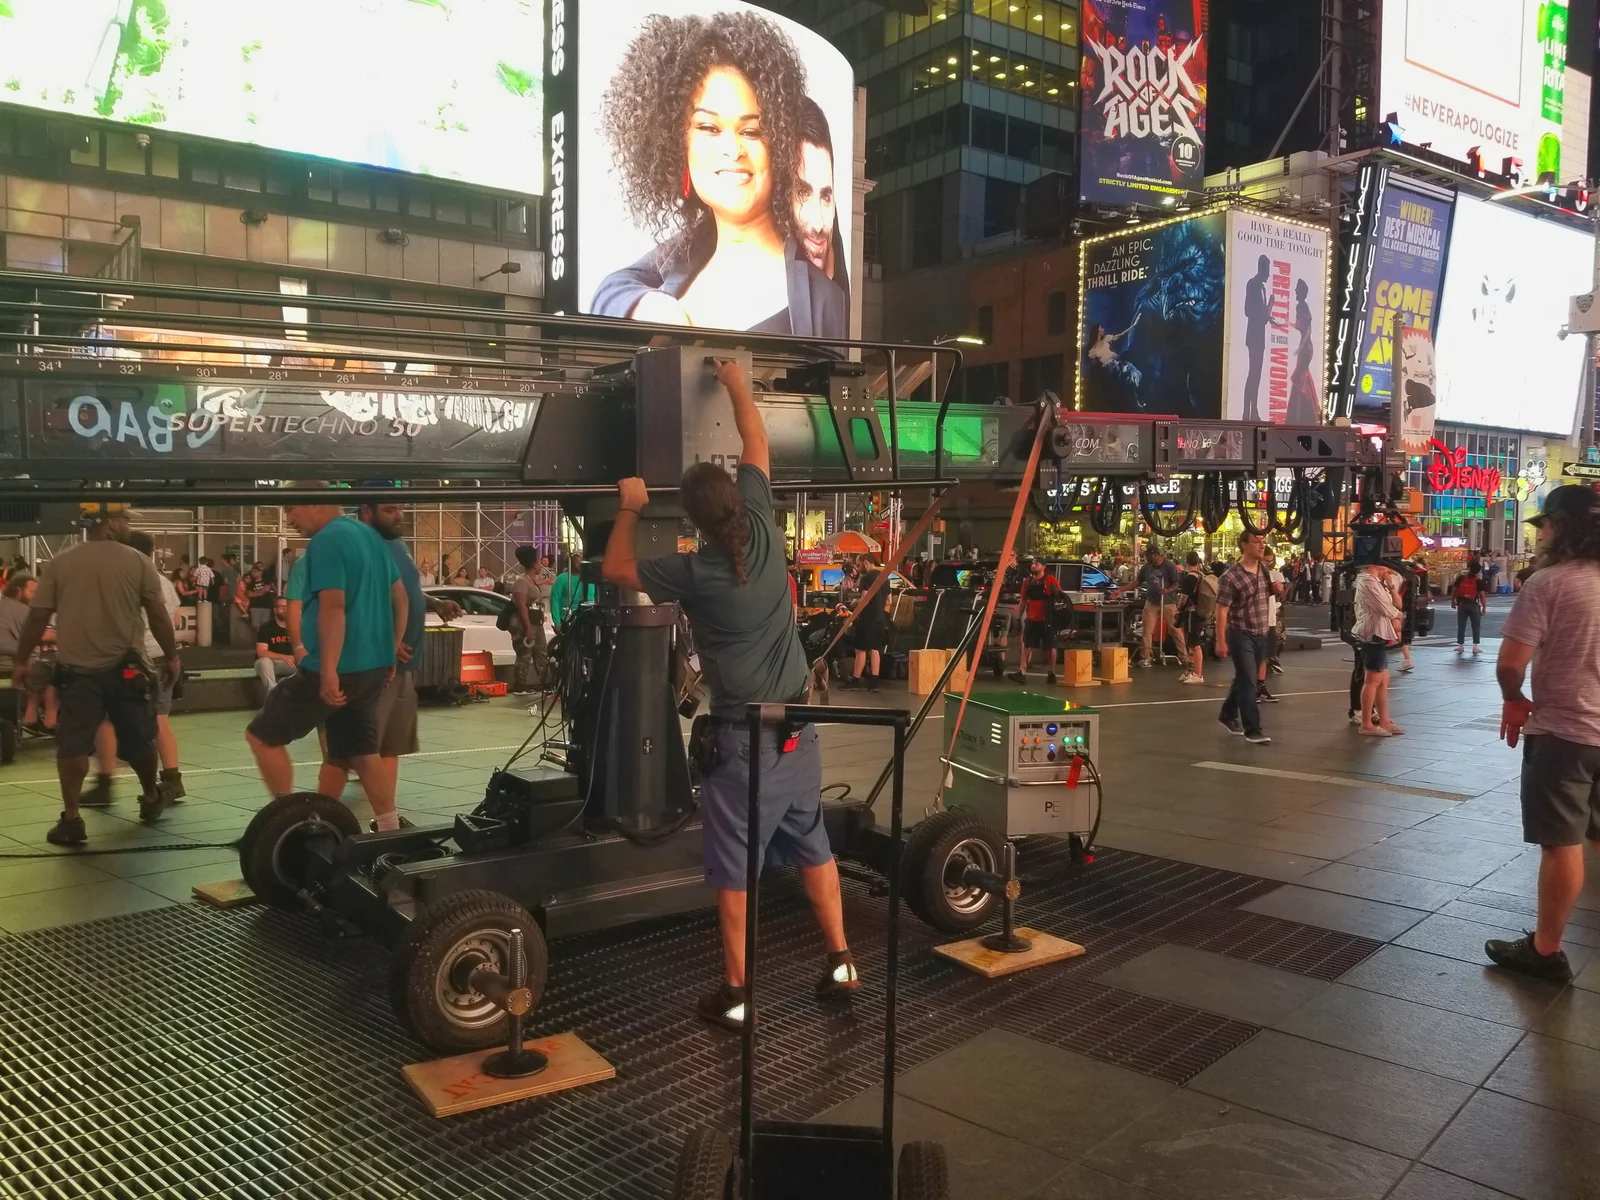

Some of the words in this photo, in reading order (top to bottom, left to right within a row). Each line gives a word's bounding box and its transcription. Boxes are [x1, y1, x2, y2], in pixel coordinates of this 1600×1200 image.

[1086, 33, 1203, 105] ROCK
[1140, 86, 1158, 101] OF
[1103, 93, 1203, 146] AGES
[1404, 92, 1519, 150] #NEVERAPOLOGIZE
[551, 111, 565, 281] EXPRESS
[1098, 178, 1126, 187] STRICTLY
[1126, 181, 1150, 191] LIMITED
[1400, 200, 1433, 226] WINNER!
[1237, 230, 1262, 245] GOOD
[1265, 236, 1286, 250] TIME
[1288, 242, 1324, 258] TONIGHT
[1251, 220, 1273, 235] HAVE
[1274, 227, 1280, 236] A
[1283, 228, 1313, 244] REALLY
[1384, 216, 1407, 240] BEST
[1406, 222, 1441, 250] MUSICAL
[1128, 238, 1154, 254] EPIC,
[1381, 238, 1391, 249] ALL
[1391, 240, 1408, 253] ACROSS
[1408, 244, 1422, 256] NORTH
[1421, 247, 1440, 261] AMERICA
[1093, 254, 1141, 275] DAZZLING
[1087, 273, 1119, 290] THRILL
[1270, 260, 1292, 334] PRETTY
[1376, 280, 1434, 318] COME
[1269, 347, 1289, 425] WOMAN
[169, 411, 378, 436] SUPERTECHNO
[389, 417, 424, 438] 50
[1568, 466, 1582, 475] ONE
